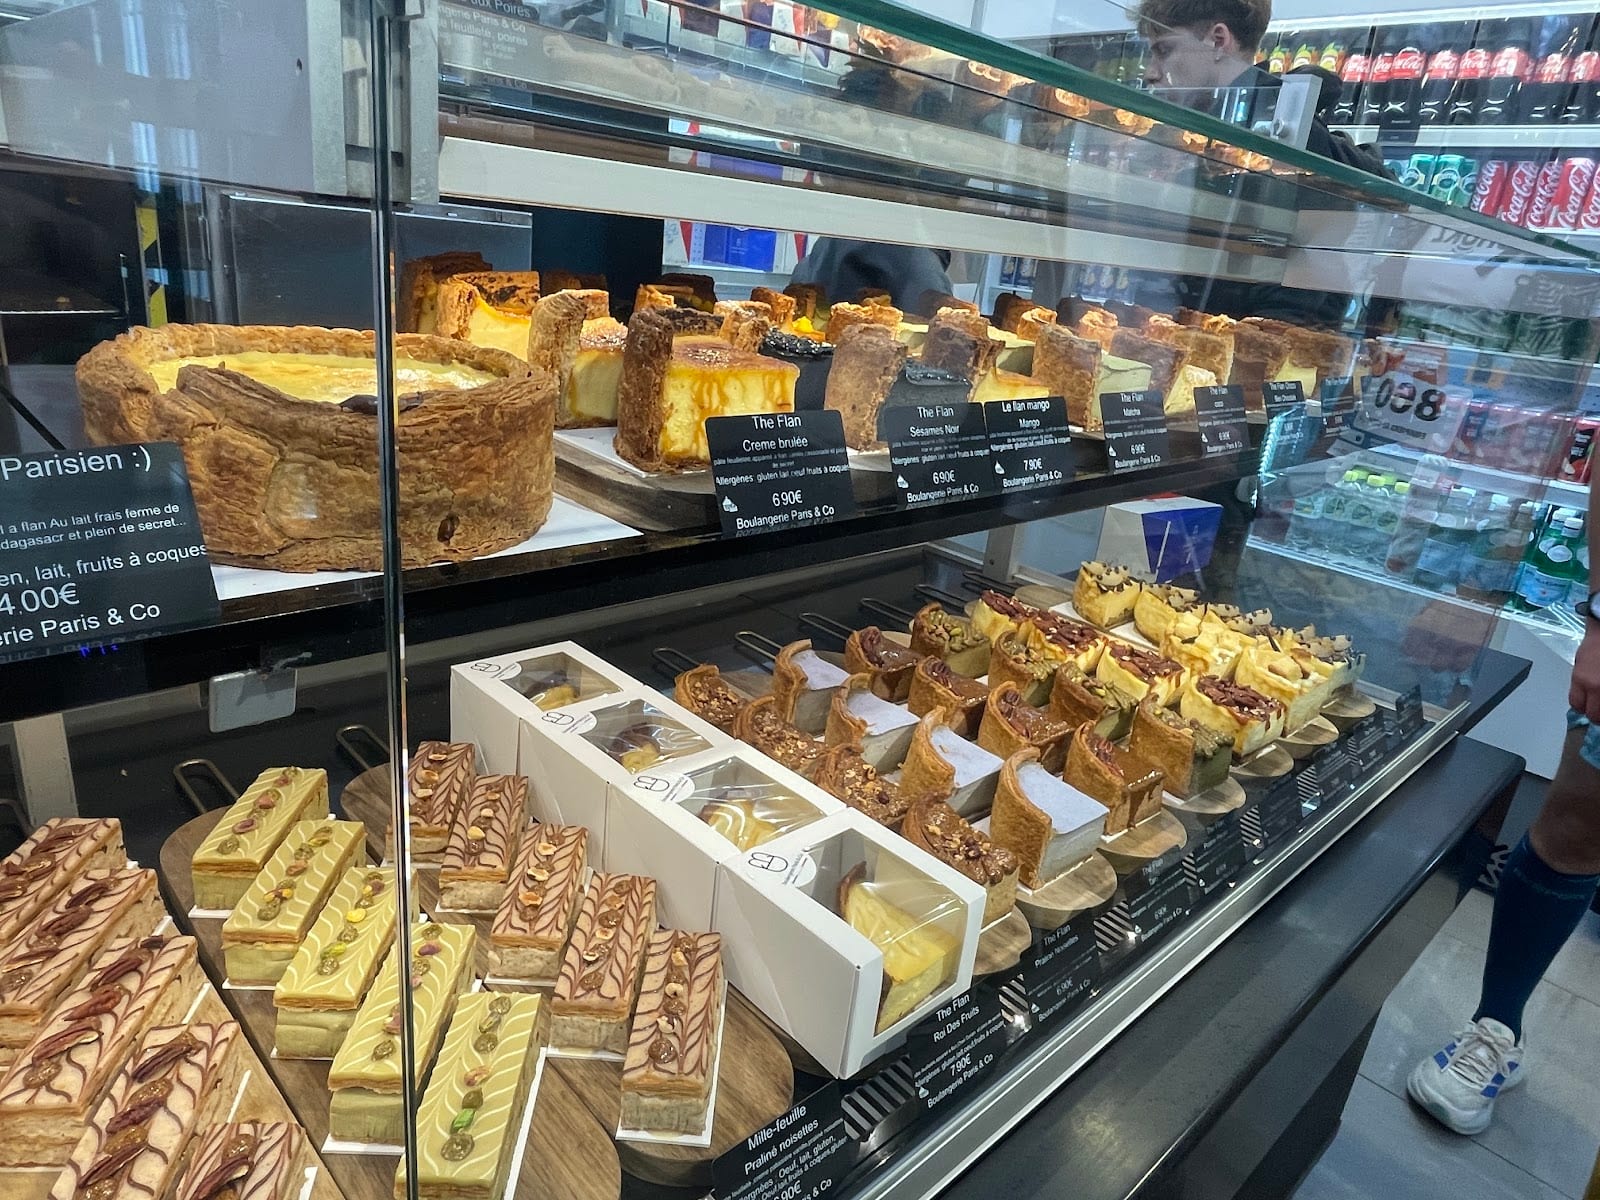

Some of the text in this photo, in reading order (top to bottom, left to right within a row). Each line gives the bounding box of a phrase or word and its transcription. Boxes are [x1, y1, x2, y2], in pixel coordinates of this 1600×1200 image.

[917, 406, 954, 420] The Flan
[1026, 400, 1050, 412] mango
[752, 414, 802, 430] The Flan
[1, 451, 123, 480] Parisien
[969, 482, 979, 492] Co
[21, 520, 47, 532] flan
[50, 517, 68, 528] Au
[72, 515, 91, 526] lait
[94, 510, 122, 522] frais
[124, 507, 160, 520] ferme
[164, 503, 180, 514] de
[736, 513, 790, 530] Boulangerie
[790, 508, 813, 520] Paris
[814, 506, 821, 516] &
[822, 504, 835, 516] Co
[68, 531, 82, 541] et
[85, 525, 116, 541] plein
[119, 522, 135, 534] de
[34, 564, 72, 582] lait,
[76, 556, 124, 575] fruits
[129, 552, 142, 567] à
[146, 544, 208, 563] coques
[40, 613, 100, 638] Paris
[107, 608, 124, 626] &
[129, 603, 161, 621] Co
[936, 994, 970, 1022] The Flan
[933, 1027, 947, 1042] Roi
[960, 1006, 980, 1024] Fruits
[963, 1065, 979, 1081] Paris
[979, 1060, 984, 1069] &
[984, 1054, 994, 1064] Co
[748, 1105, 807, 1151] Mille-feuille
[744, 1119, 819, 1176] Praliné noisettes
[812, 1187, 819, 1197] &
[820, 1178, 832, 1191] Co
